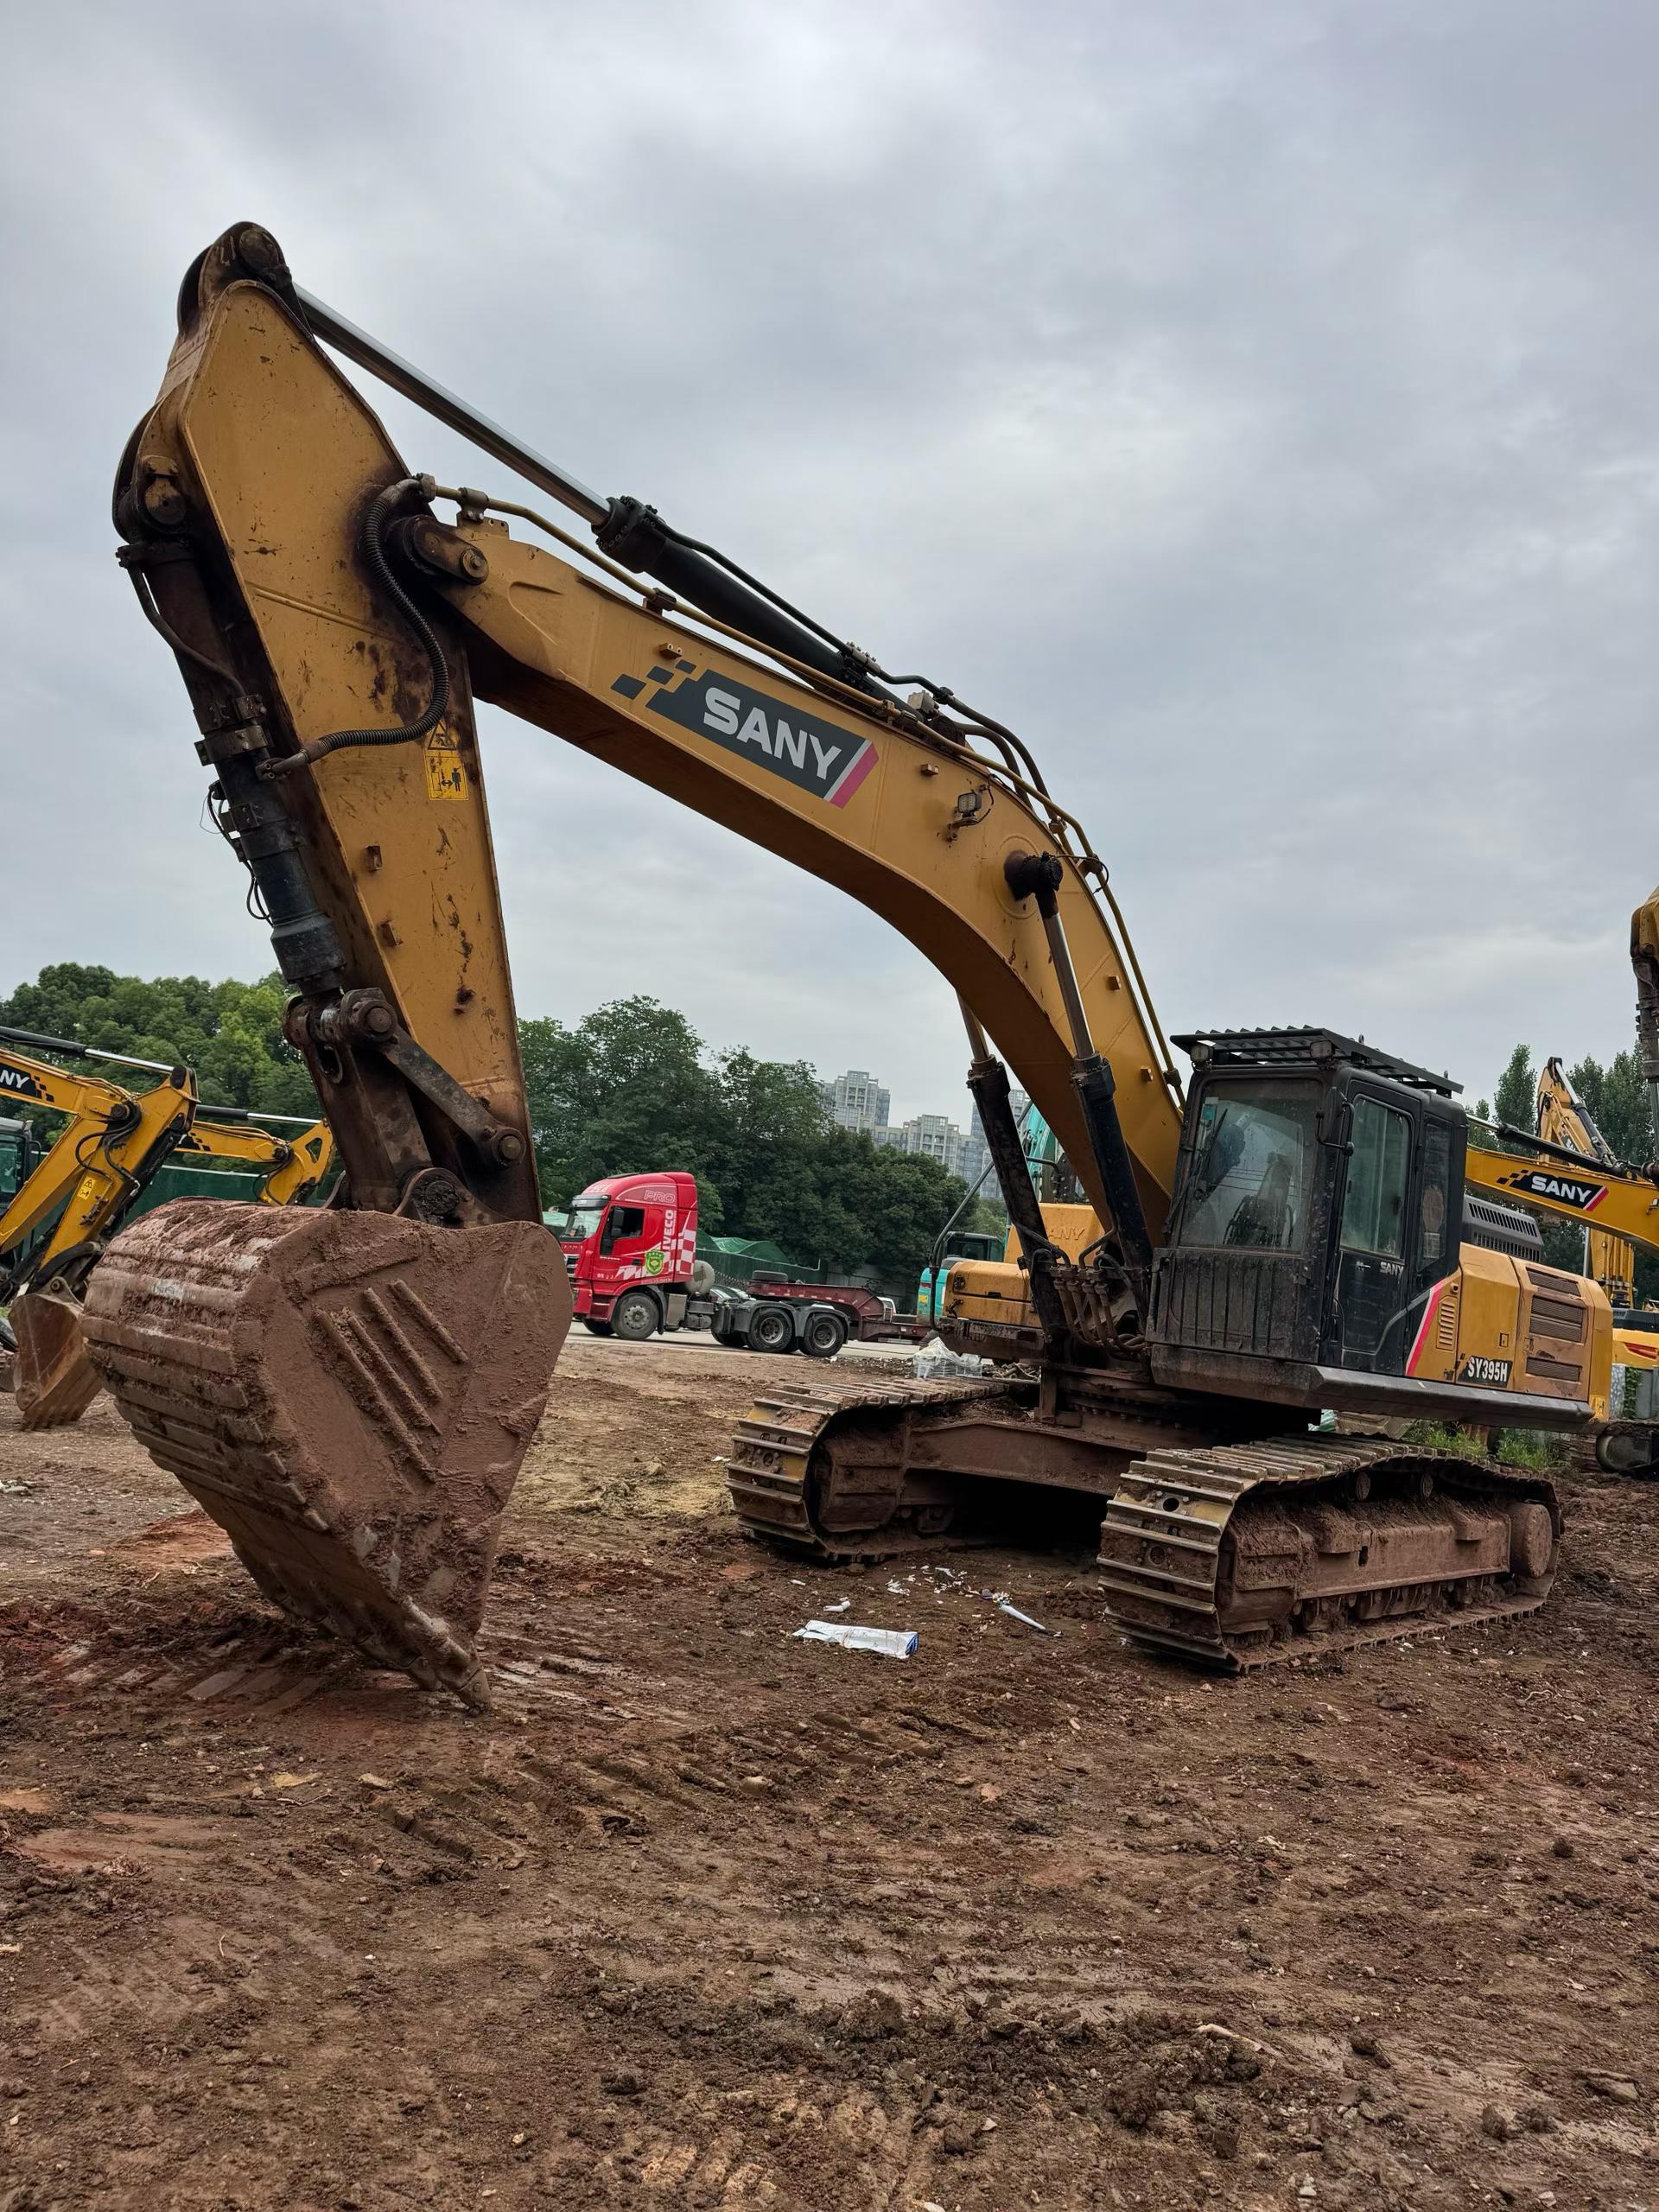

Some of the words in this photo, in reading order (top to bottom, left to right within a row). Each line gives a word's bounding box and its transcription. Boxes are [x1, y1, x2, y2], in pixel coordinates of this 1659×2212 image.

[703, 687, 842, 780] SANY
[644, 1190, 676, 1204] PRO
[1530, 1175, 1592, 1203] SANY
[662, 1210, 674, 1250] IVECO
[1047, 1226, 1085, 1241] ANY
[1380, 1262, 1404, 1279] SANY
[1467, 1357, 1508, 1382] SY395H
